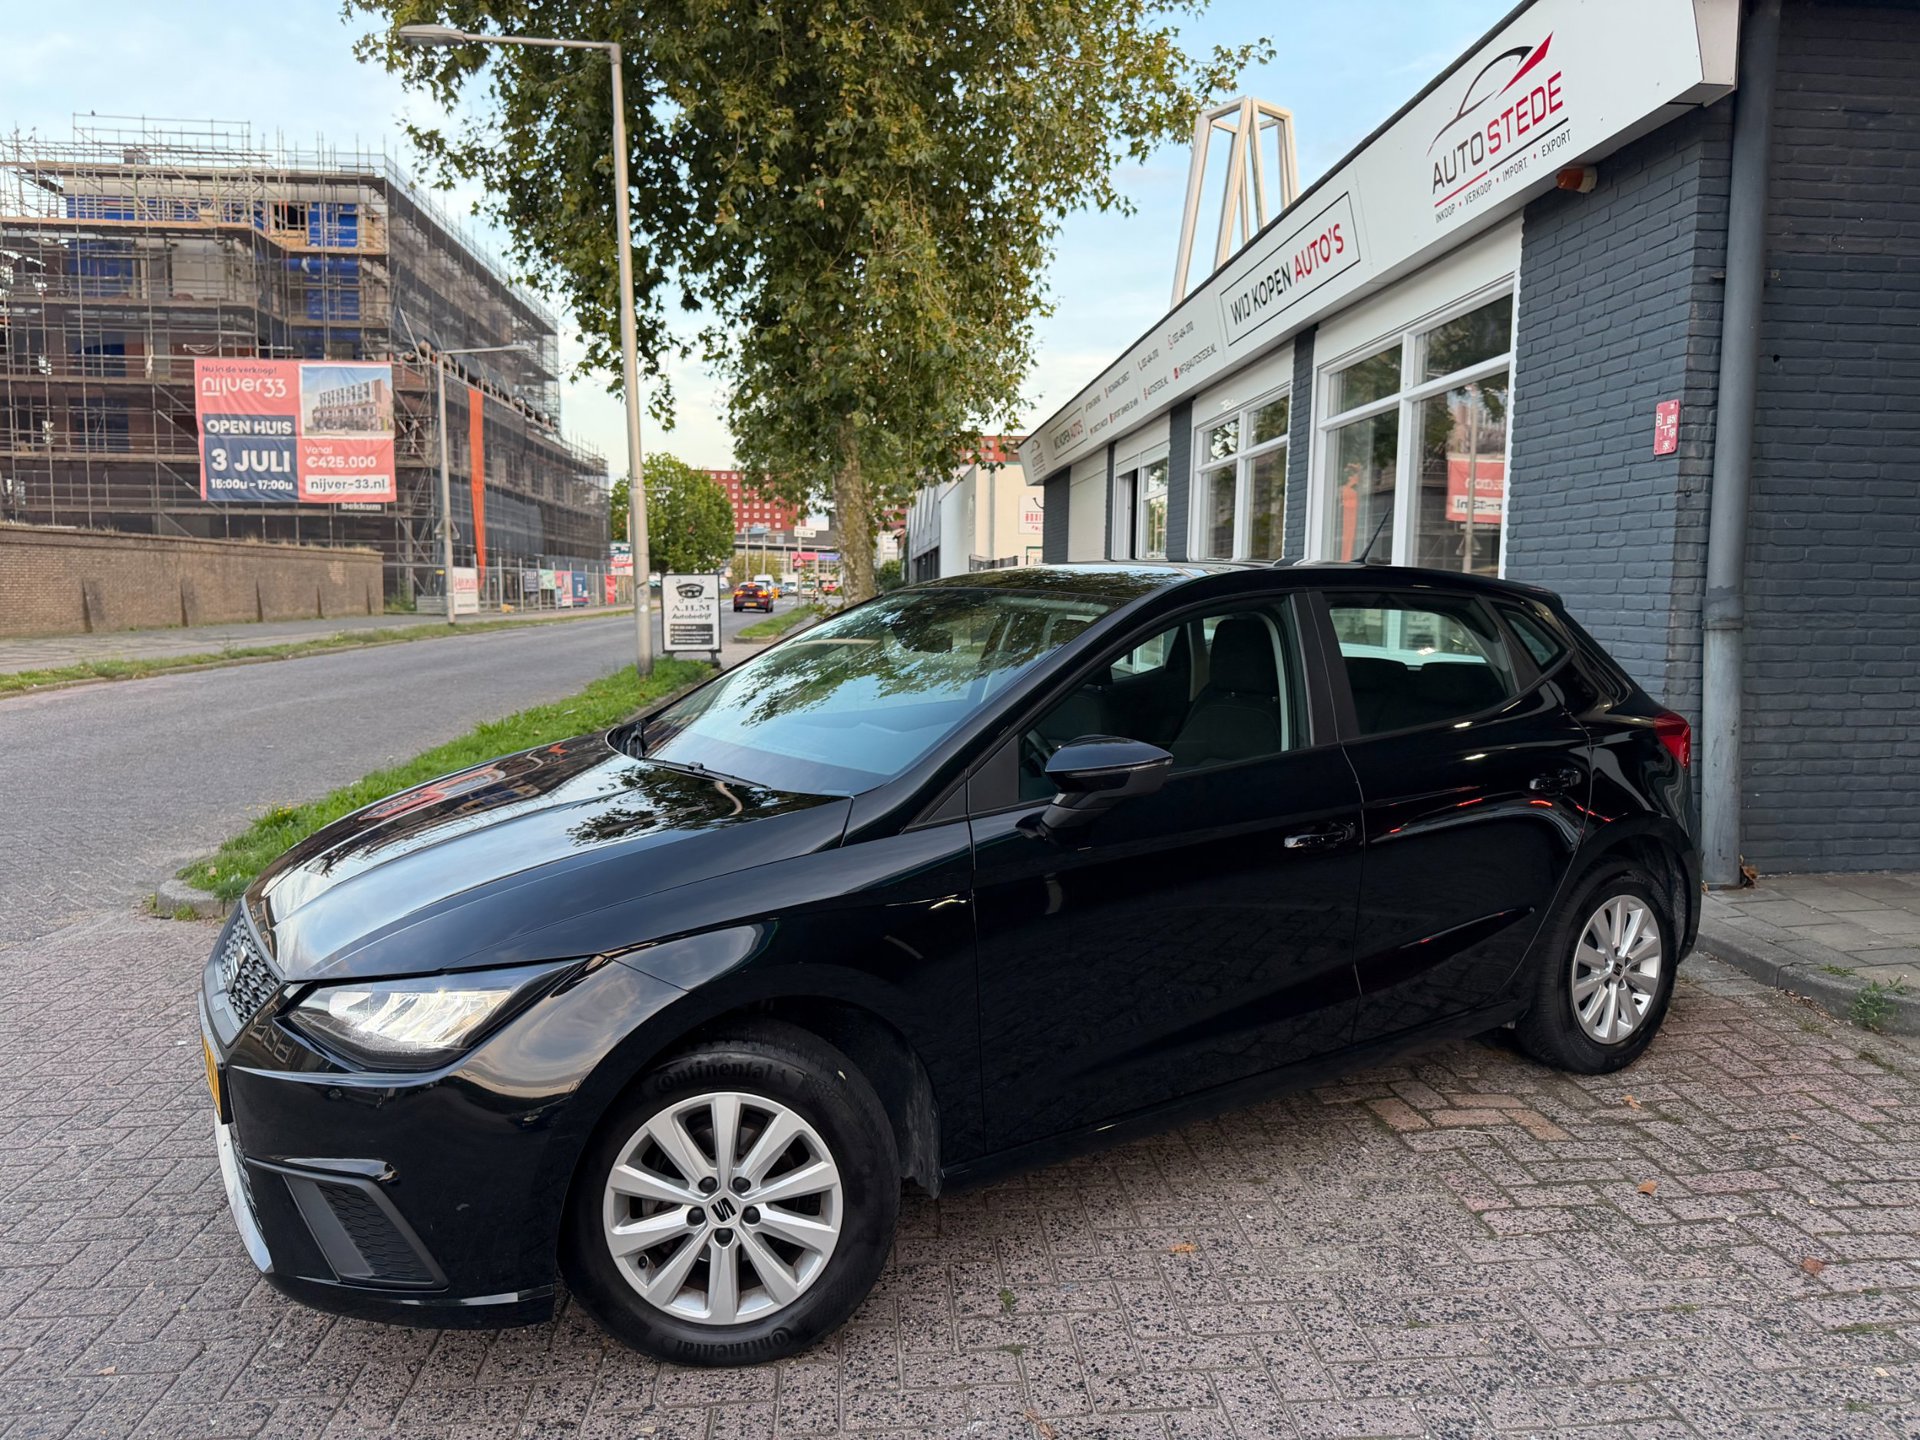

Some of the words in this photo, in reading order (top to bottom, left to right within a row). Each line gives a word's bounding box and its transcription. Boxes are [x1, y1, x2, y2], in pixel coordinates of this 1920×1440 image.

[1432, 71, 1563, 194] AUTOSTEDE
[1435, 202, 1456, 223] INKOOP
[1464, 180, 1493, 205] VERKOOP
[1502, 157, 1528, 181] IMPORT
[1541, 129, 1571, 157] EXPORT
[1230, 294, 1251, 325] WIJ
[1251, 262, 1292, 312] KOPEN
[1294, 223, 1344, 283] AUTO'S
[215, 365, 224, 374] in
[226, 366, 237, 374] de
[239, 366, 277, 376] verkoop!
[206, 420, 251, 434] OPEN
[254, 421, 292, 435] HUIS
[211, 448, 228, 471] 3
[234, 449, 291, 473] JULI
[306, 456, 377, 469] €425.000
[258, 479, 293, 491] 17:00u
[310, 478, 386, 493] nijver-33.nl
[655, 1060, 774, 1093] Continental
